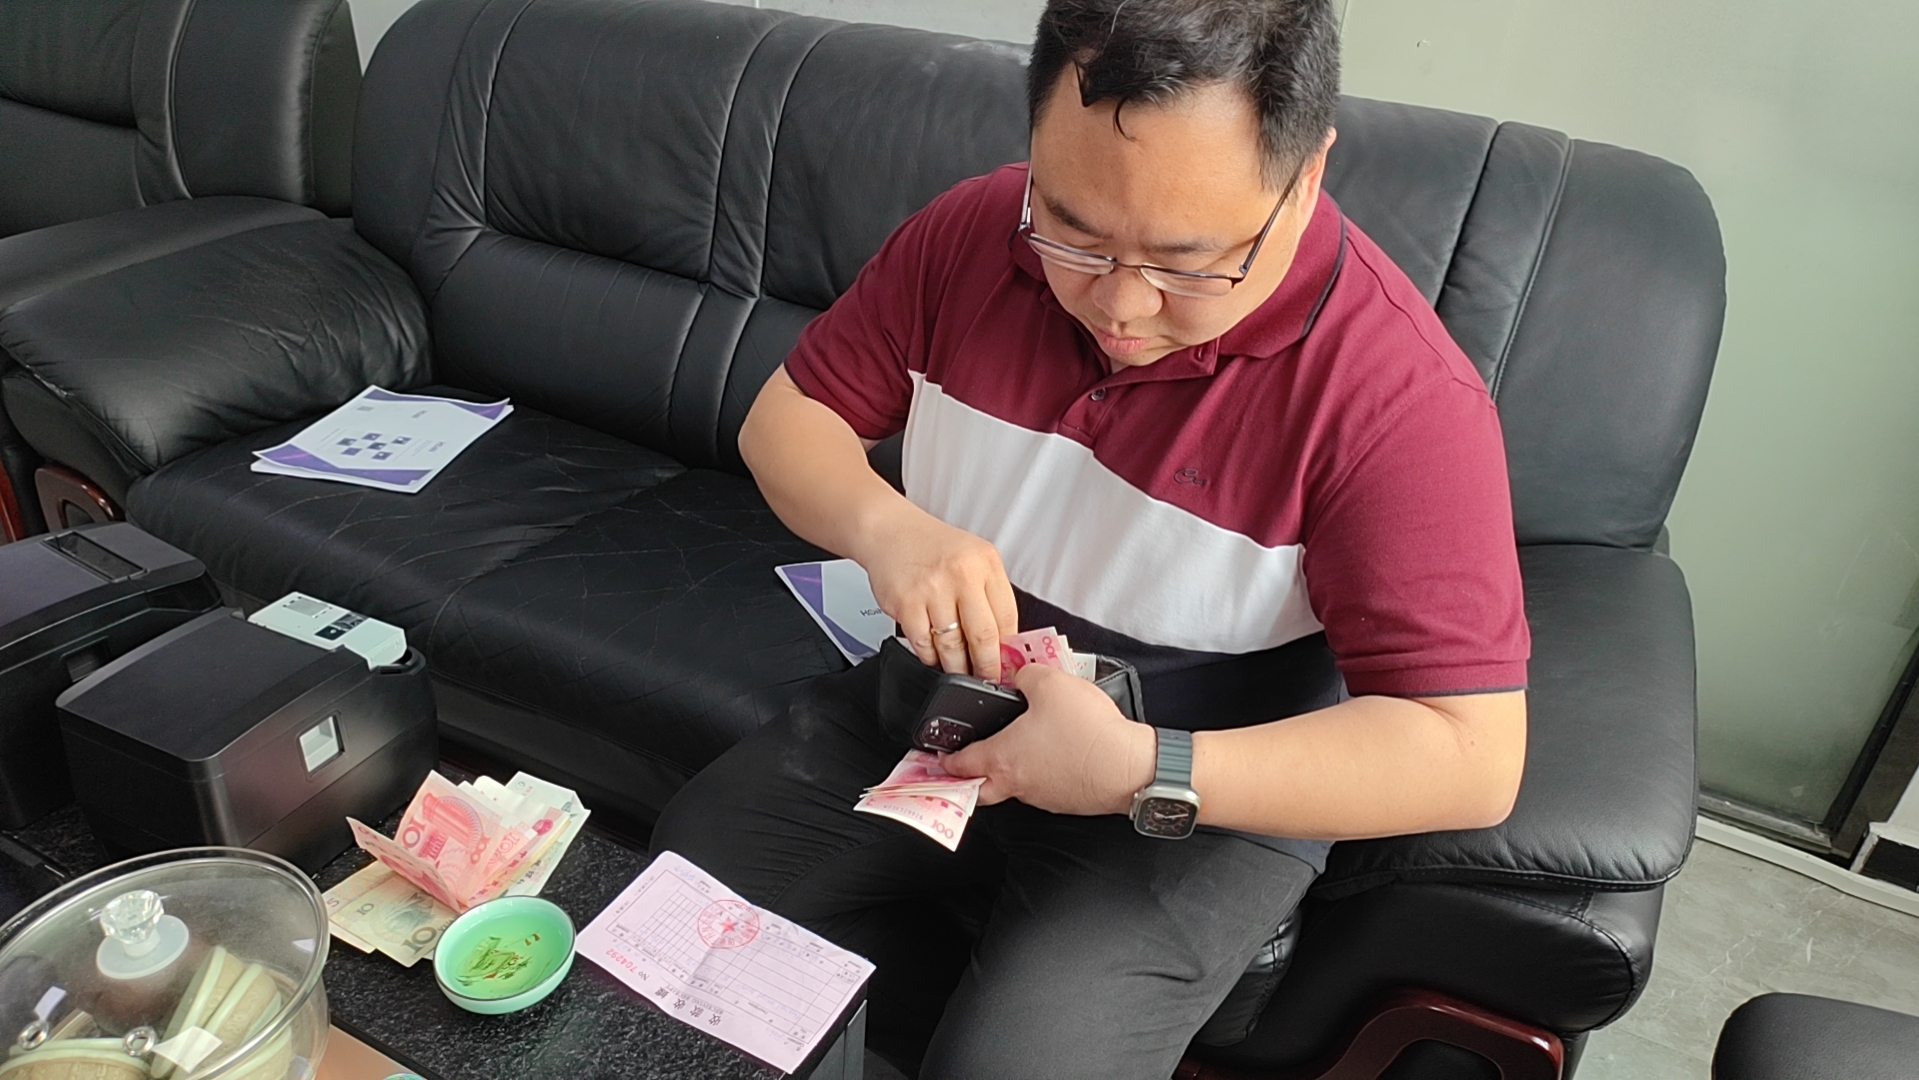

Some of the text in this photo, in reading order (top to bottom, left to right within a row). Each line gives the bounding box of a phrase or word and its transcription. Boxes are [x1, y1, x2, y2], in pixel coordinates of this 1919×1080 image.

[1042, 636, 1057, 659] 100
[931, 819, 955, 839] 100
[326, 897, 340, 908] 5
[356, 903, 375, 916] 10
[401, 926, 437, 955] 10
[605, 948, 638, 974] 704292
